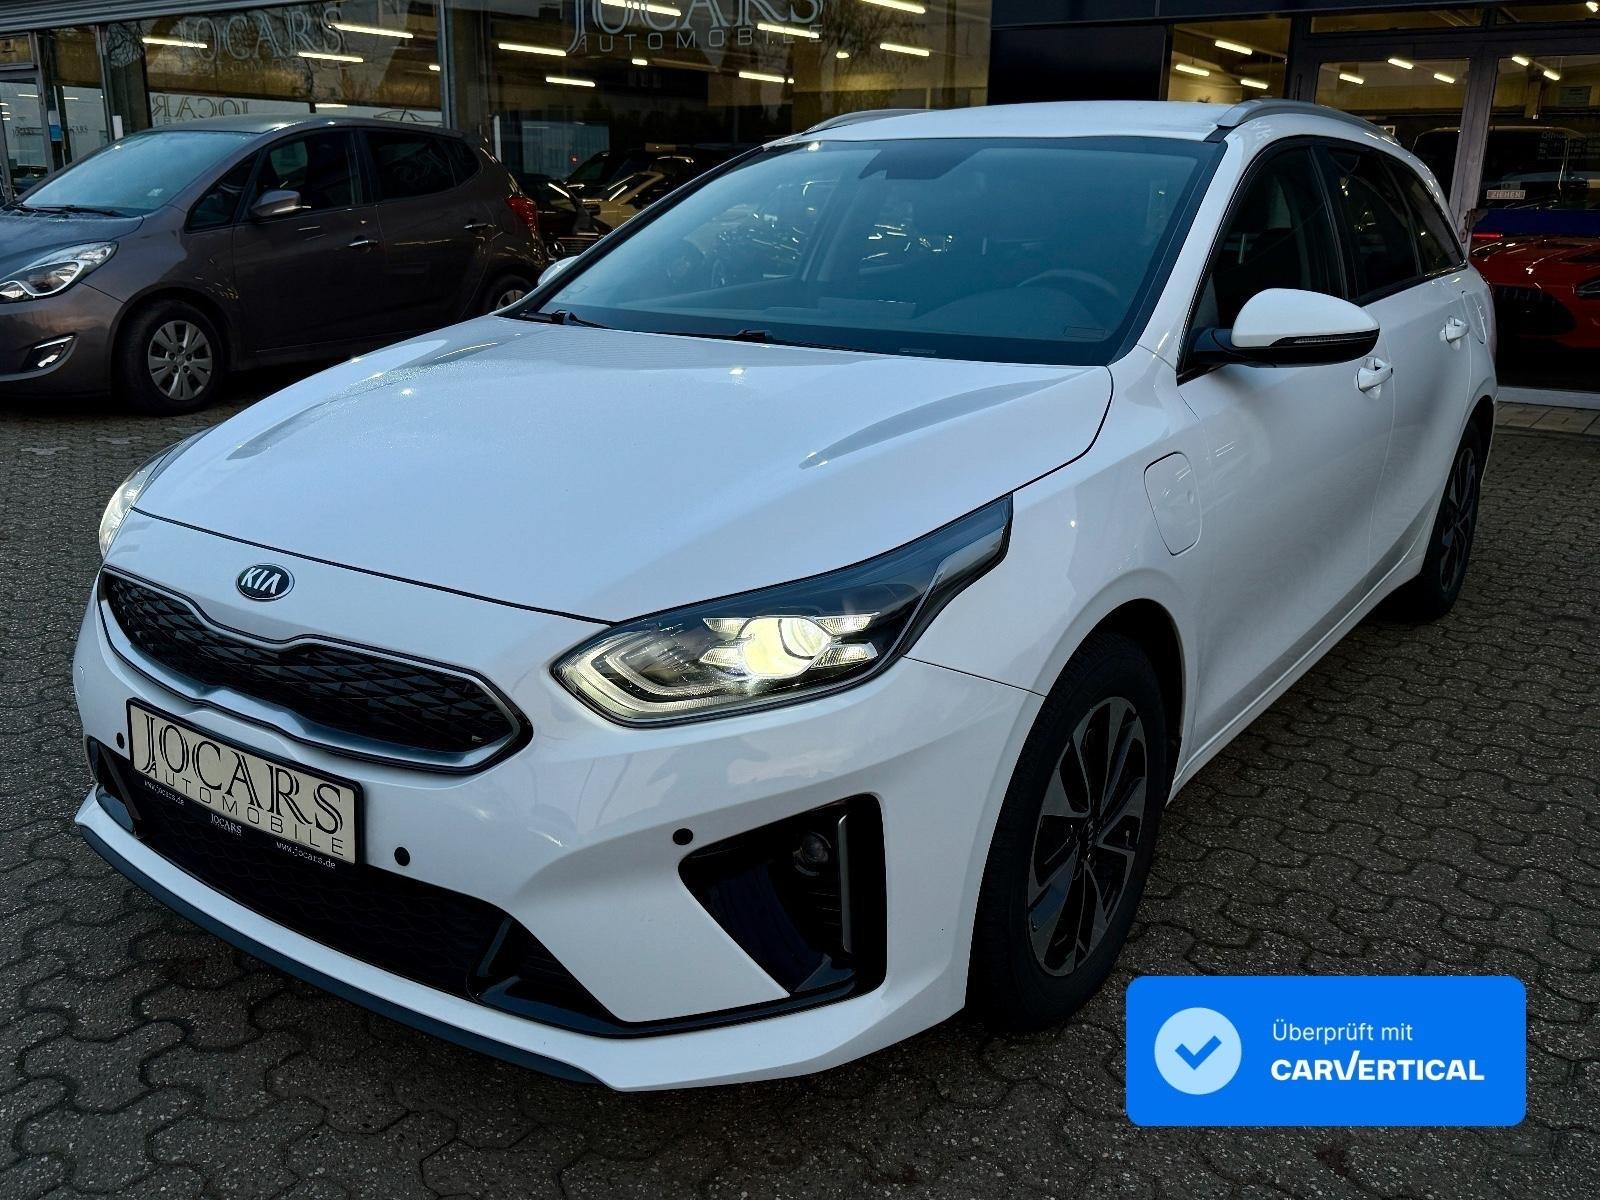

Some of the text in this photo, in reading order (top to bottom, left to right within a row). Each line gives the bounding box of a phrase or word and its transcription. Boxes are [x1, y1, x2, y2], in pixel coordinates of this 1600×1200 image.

[577, 24, 823, 53] AUTOMOBILE
[240, 567, 282, 594] KIA
[141, 714, 344, 834] JOCARS
[146, 761, 344, 857] AUTOMOBILE
[210, 813, 243, 835] JOCARS
[276, 841, 336, 869] www.jocars.de
